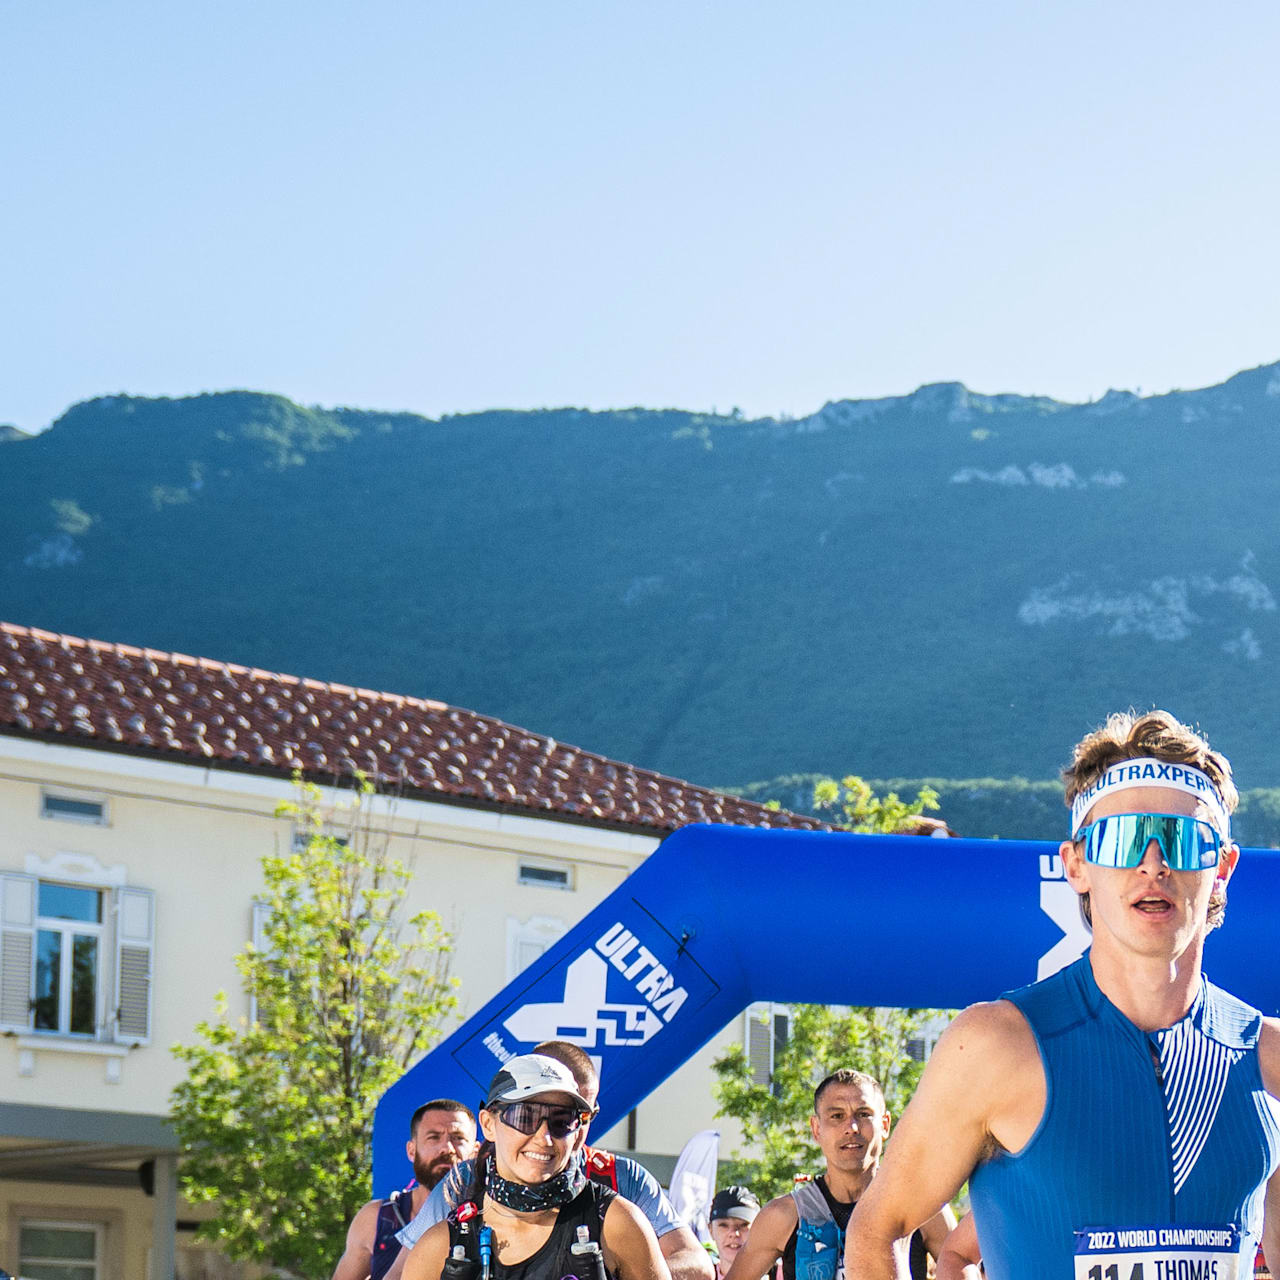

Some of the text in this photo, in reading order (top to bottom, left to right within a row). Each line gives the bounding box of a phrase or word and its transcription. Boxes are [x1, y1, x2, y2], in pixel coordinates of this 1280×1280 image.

[594, 921, 689, 1024] ULTRA
[1088, 1229, 1232, 1249] 2022 WORLD CHAMPIONSHIPS
